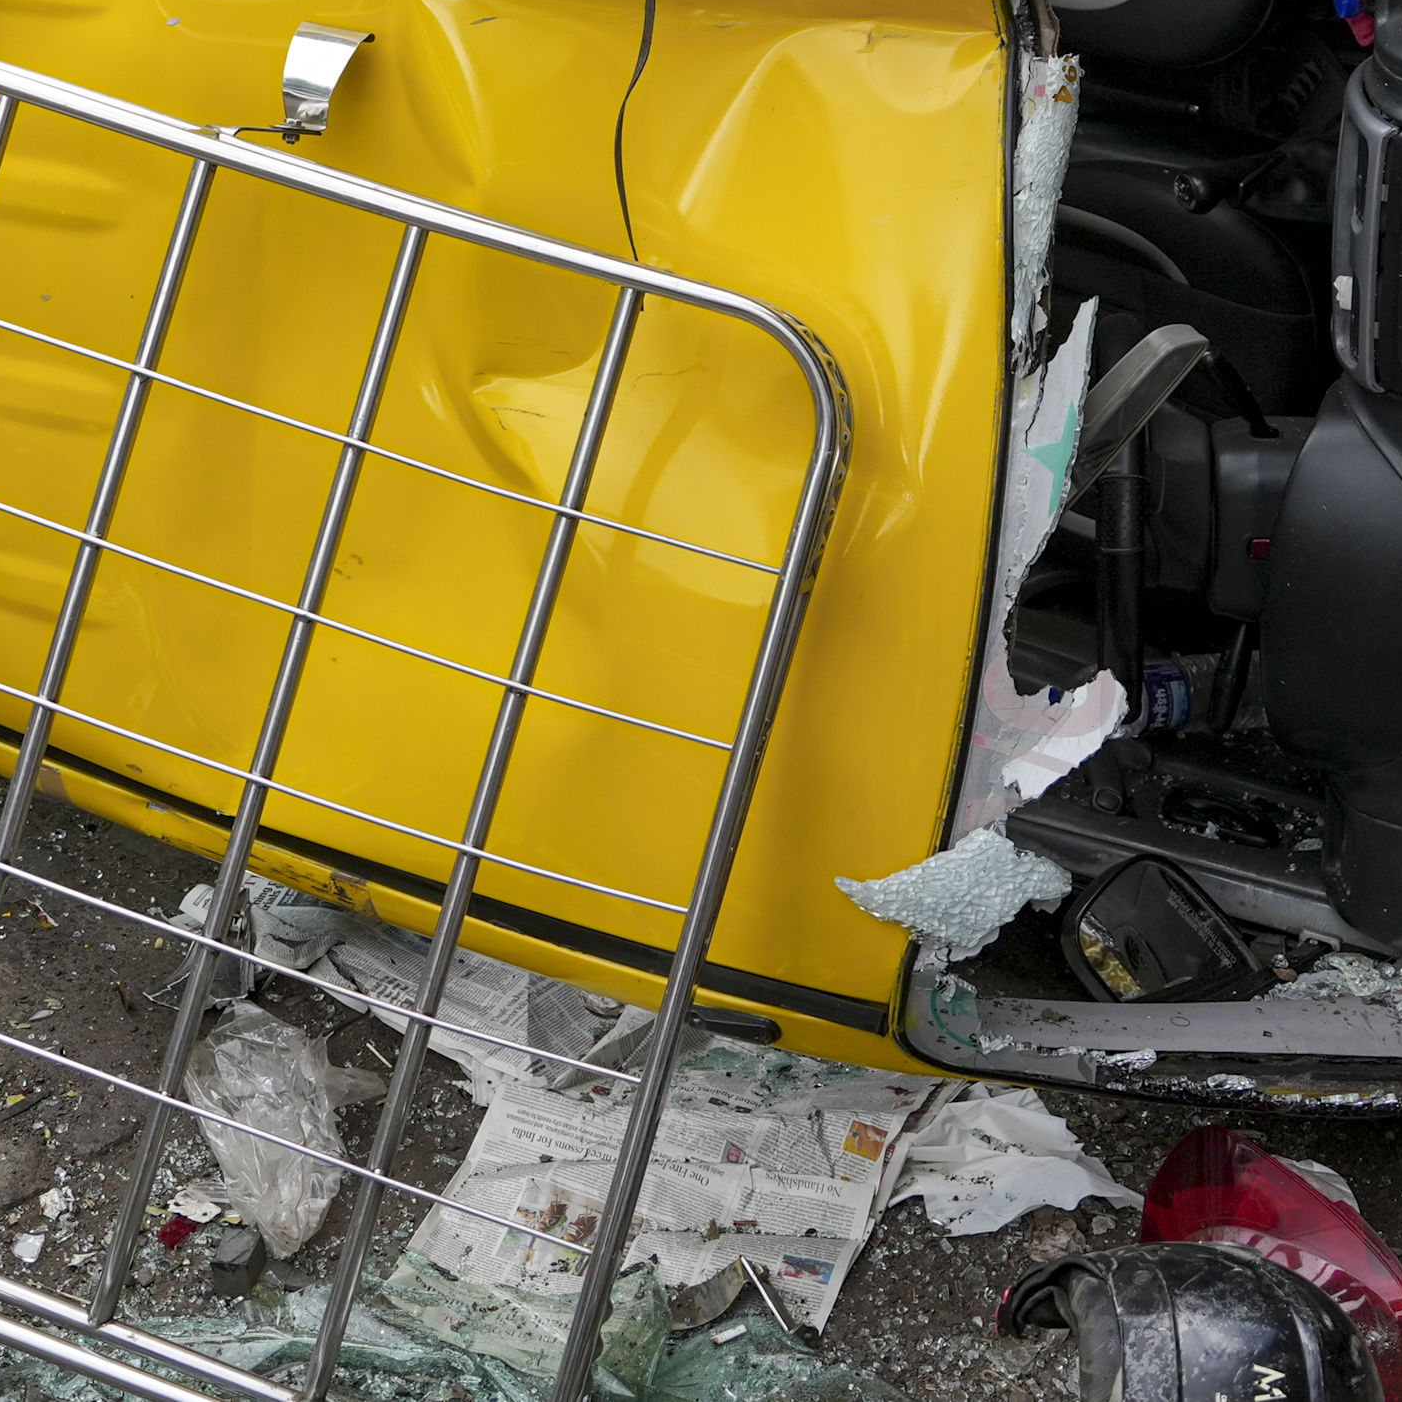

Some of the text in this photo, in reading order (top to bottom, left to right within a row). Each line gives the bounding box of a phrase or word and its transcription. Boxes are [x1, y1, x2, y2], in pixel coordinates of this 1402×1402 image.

[510, 1126, 536, 1142] India
[535, 1134, 552, 1147] For
[667, 1162, 688, 1178] Fire
[687, 1170, 710, 1187] One
[763, 1171, 842, 1197] No Handshakes
